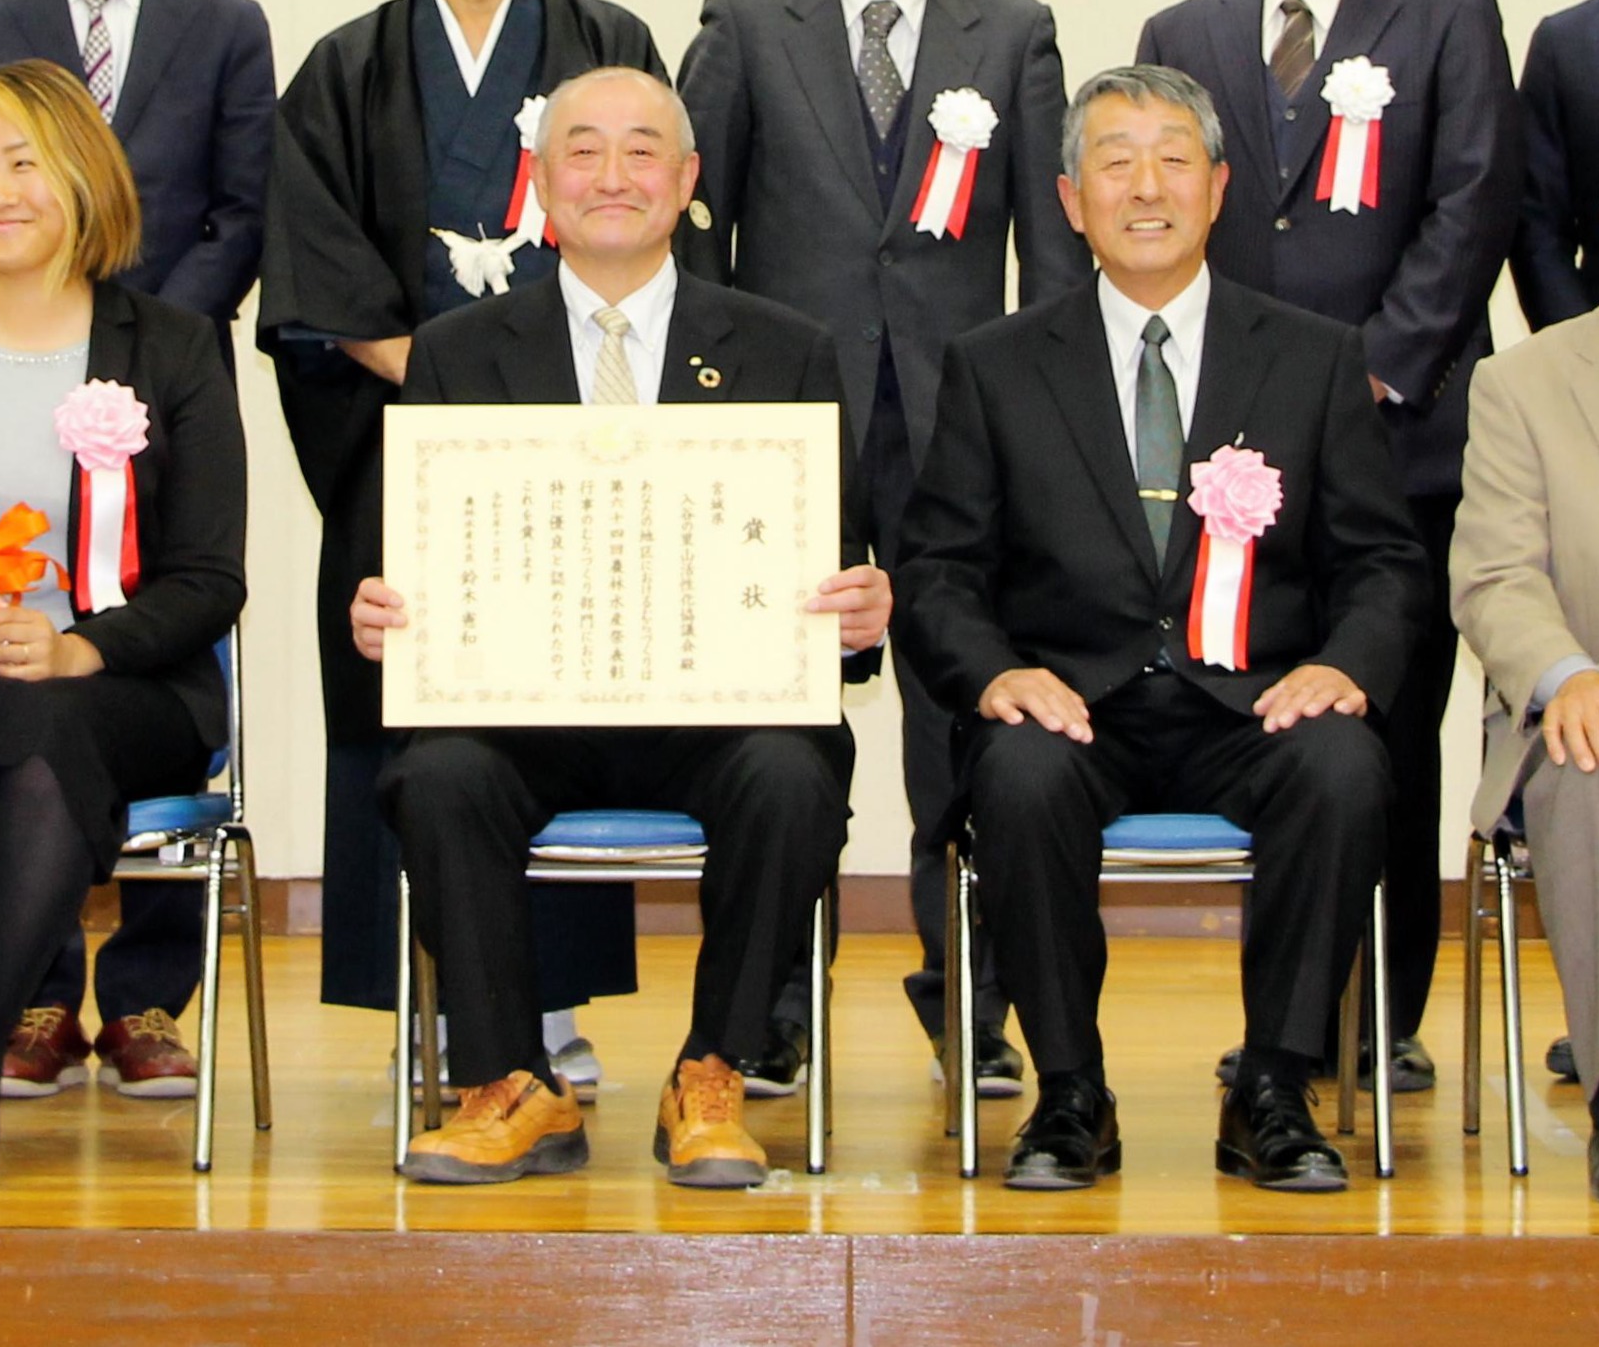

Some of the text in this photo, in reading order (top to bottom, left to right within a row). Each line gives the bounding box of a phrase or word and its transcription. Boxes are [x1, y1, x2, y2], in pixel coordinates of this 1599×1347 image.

[710, 481, 725, 526] 宮城県
[740, 516, 769, 610] 賞状
